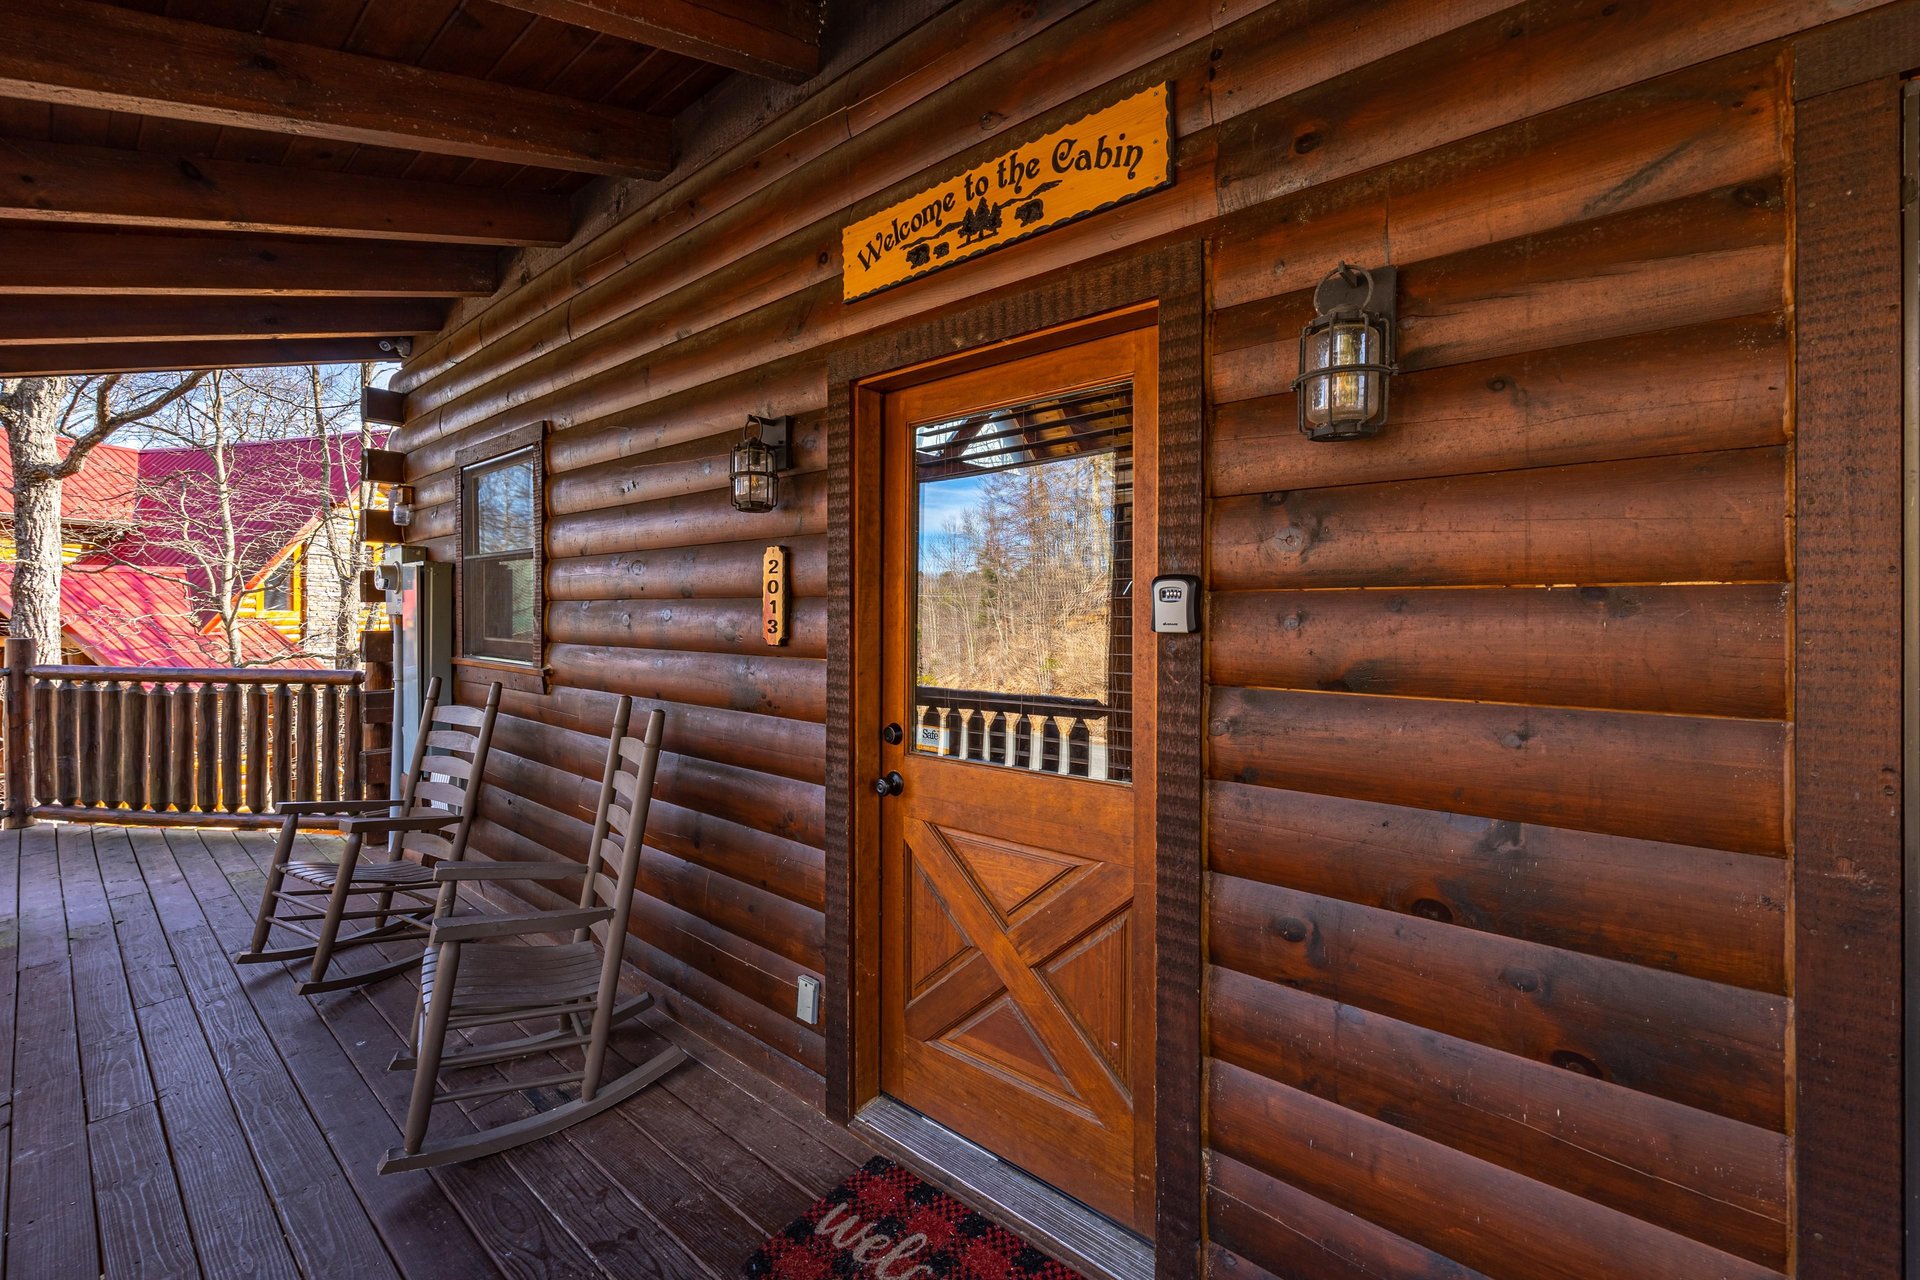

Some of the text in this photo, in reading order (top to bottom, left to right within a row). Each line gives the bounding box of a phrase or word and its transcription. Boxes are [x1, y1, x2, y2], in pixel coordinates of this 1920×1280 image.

[857, 133, 1144, 272] Welcome to the Cabin
[767, 560, 779, 633] 2013
